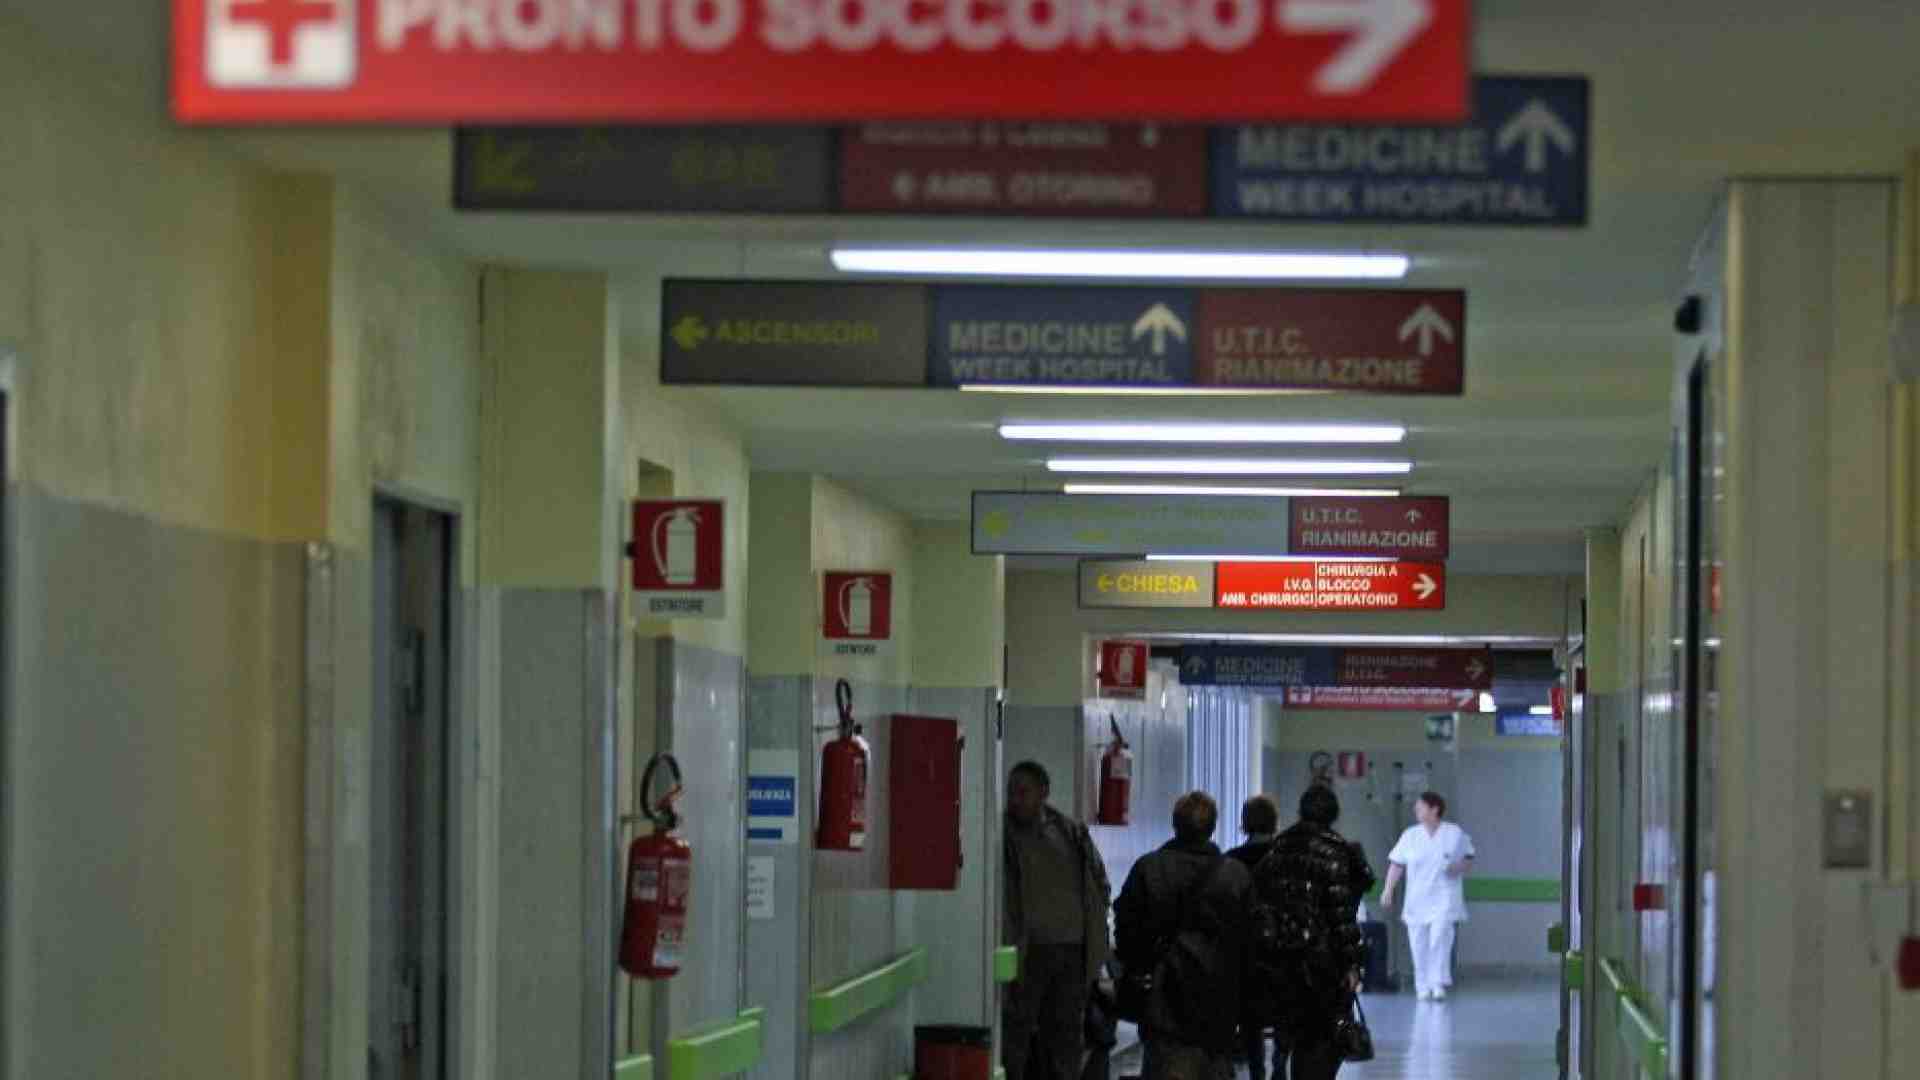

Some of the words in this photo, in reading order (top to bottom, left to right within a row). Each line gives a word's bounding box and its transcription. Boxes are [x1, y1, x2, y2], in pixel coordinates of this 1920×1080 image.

[376, 0, 740, 51] PRONTO
[758, 0, 1259, 52] SOCCORSO
[1238, 126, 1486, 172] MEDICINE
[1239, 181, 1352, 214] WEEK
[1362, 182, 1554, 217] HOSPITAL
[719, 320, 880, 346] ASCENSORI
[949, 321, 1125, 354] MEDICINE
[1212, 327, 1308, 353] U.T.I.C.
[949, 357, 1029, 380] WEEK
[1038, 358, 1171, 383] HOSPITAL
[1213, 356, 1421, 384] RIANIMAZIONE
[1302, 508, 1364, 524] U.T.I.C.
[1302, 530, 1438, 548] RIANIMAZIONE
[1317, 565, 1385, 577] CHIRURGIA
[1388, 566, 1398, 577] A
[1117, 573, 1200, 594] CHIESA
[1317, 579, 1369, 591] BLOCCO
[1250, 592, 1314, 606] CHIRURGICI
[1318, 592, 1397, 606] OPERATORIO
[1215, 655, 1305, 672] MEDICINE
